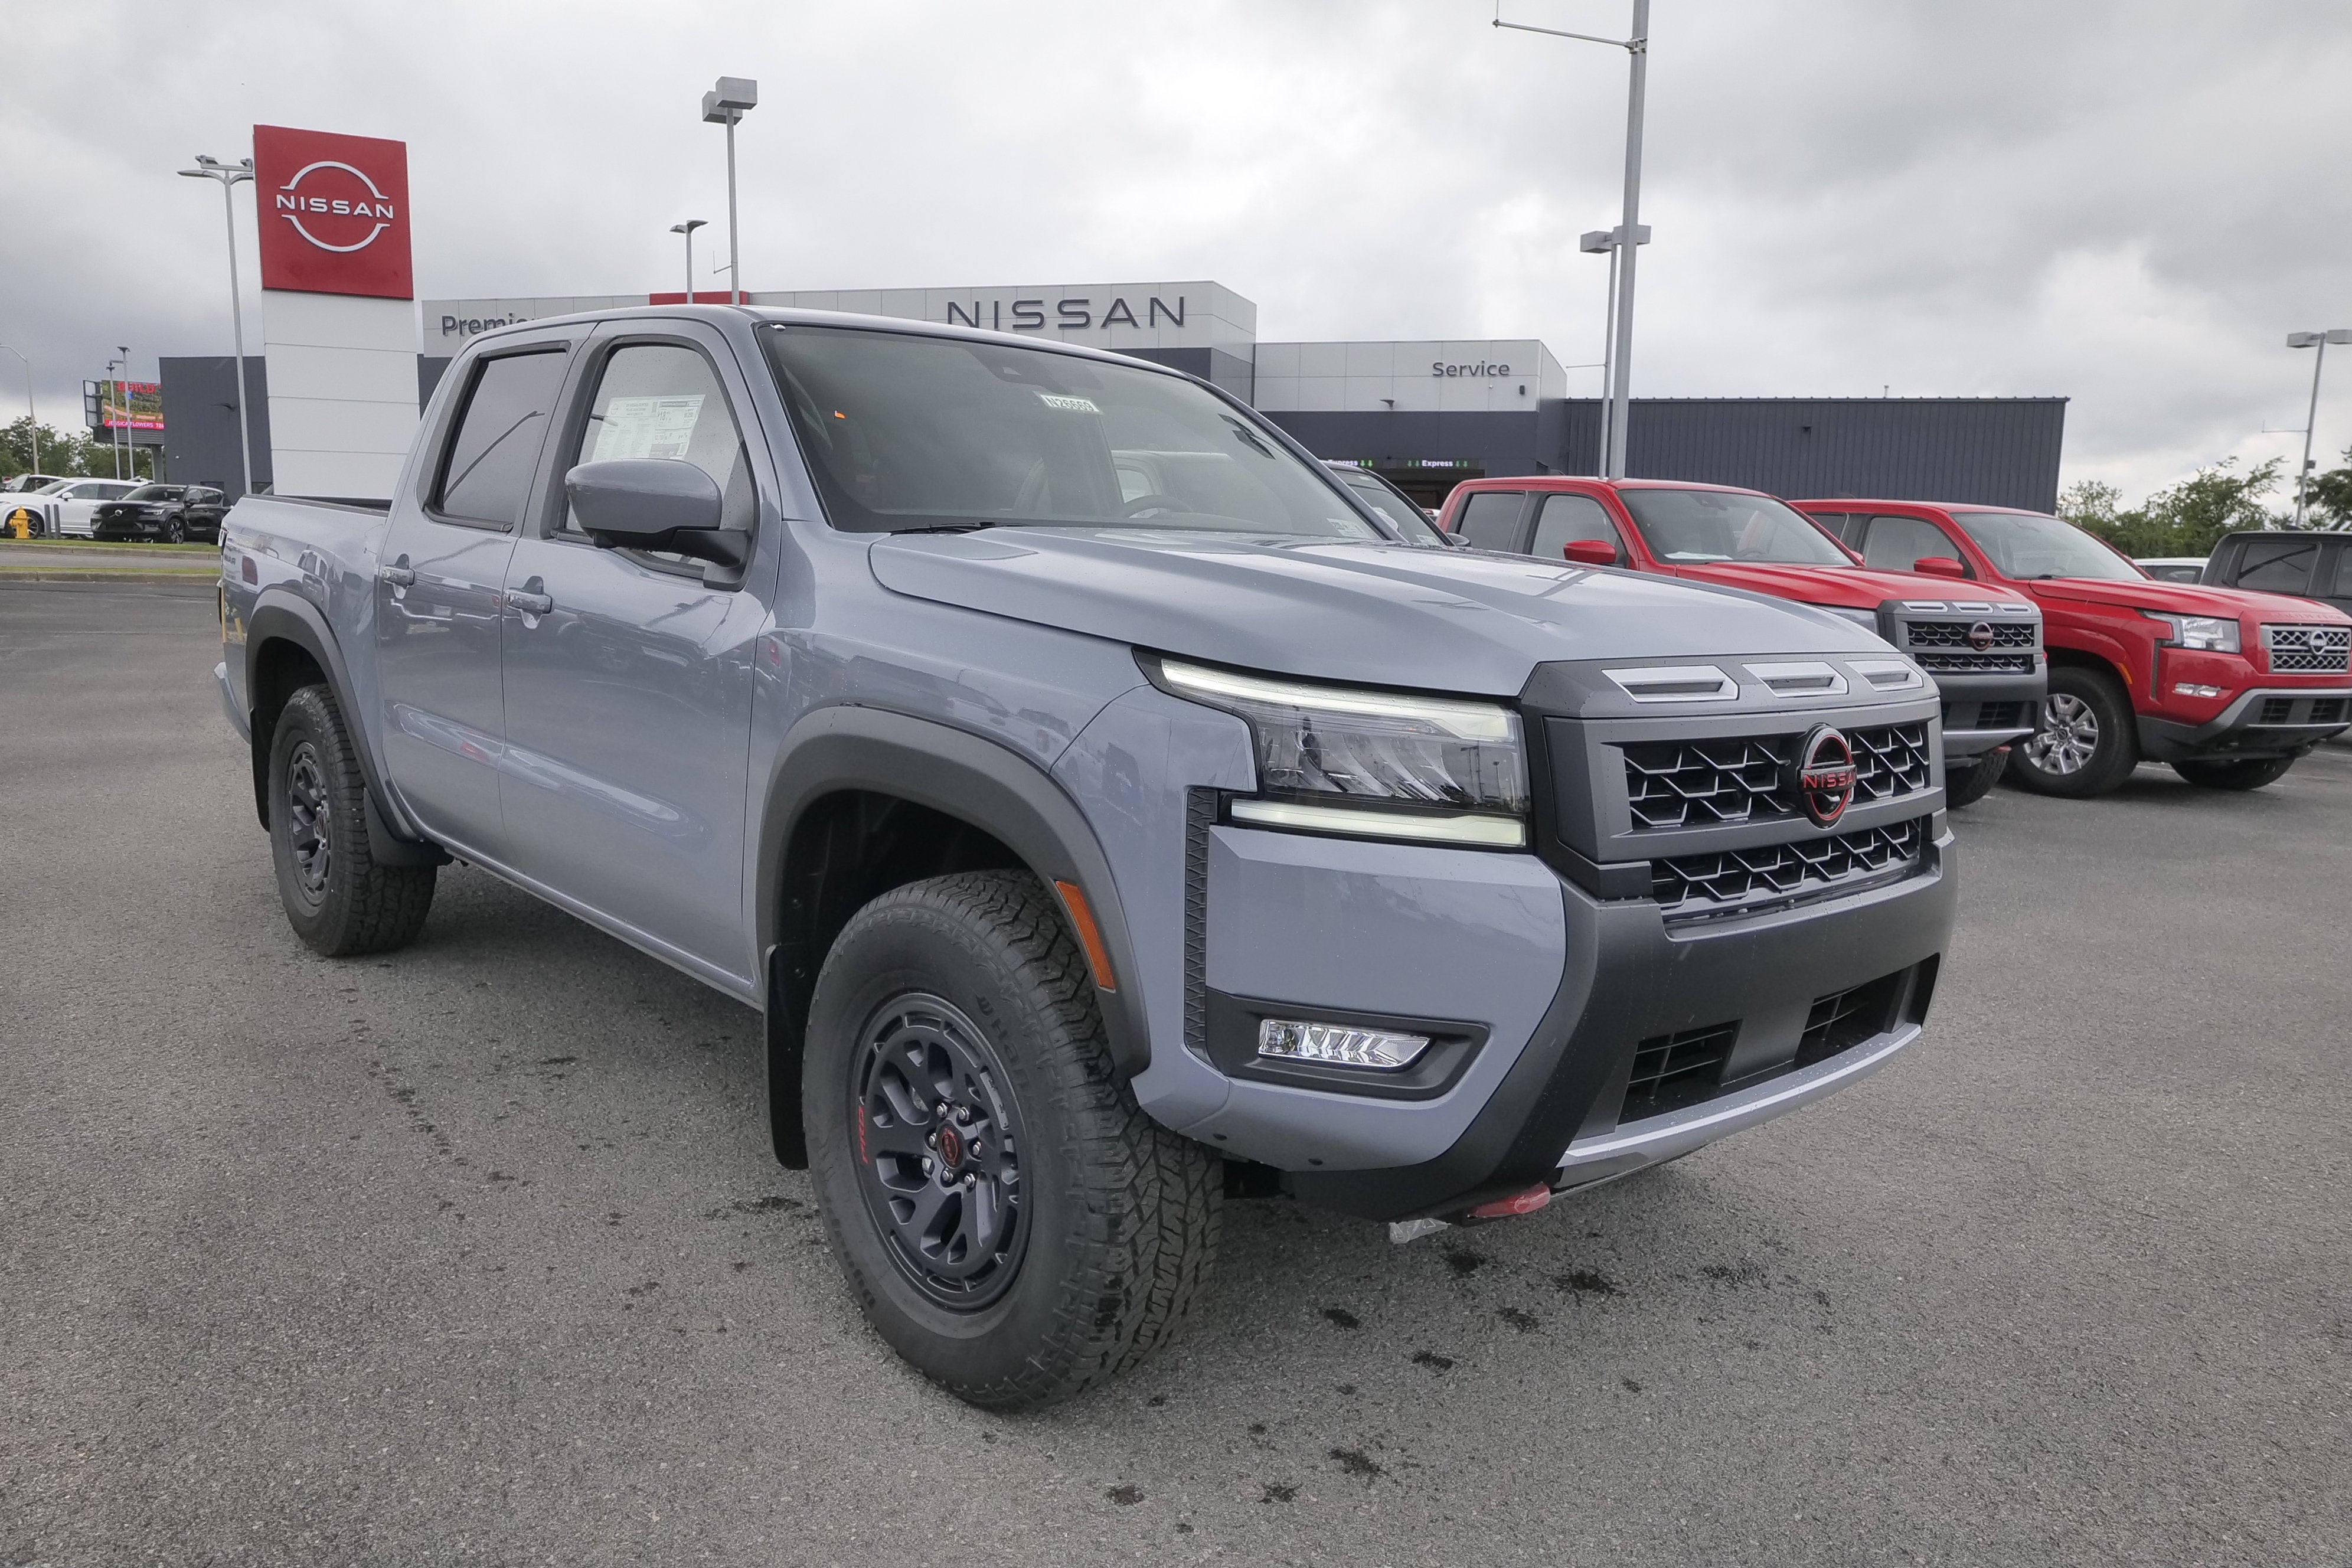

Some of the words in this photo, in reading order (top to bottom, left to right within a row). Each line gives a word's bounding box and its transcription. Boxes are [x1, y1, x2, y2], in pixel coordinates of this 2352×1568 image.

[276, 194, 394, 219] NISSAN
[948, 296, 1185, 329] NISSAN
[442, 313, 541, 335] Premi
[1432, 360, 1510, 377] Service
[117, 381, 155, 393] BUILD
